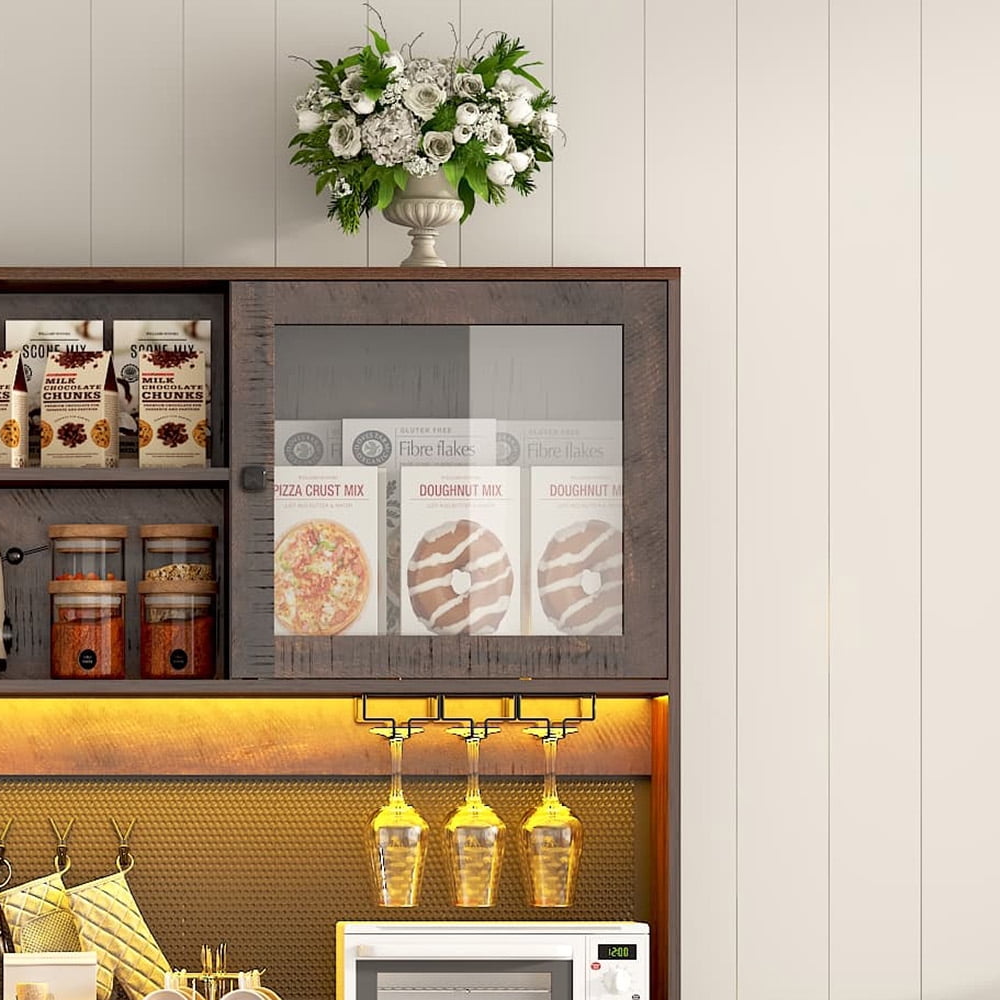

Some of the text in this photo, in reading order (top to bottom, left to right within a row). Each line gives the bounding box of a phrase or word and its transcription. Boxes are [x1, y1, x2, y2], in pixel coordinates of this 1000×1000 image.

[43, 392, 101, 400] CHUNKS
[142, 392, 203, 400] CHUNKS
[399, 440, 476, 456] Fibre flakes
[527, 442, 561, 458] Fibre
[274, 484, 364, 496] PIZZA CRUST MIX
[420, 484, 502, 496] DOUGHNUT MIX
[550, 484, 608, 497] DOUGHNUT
[608, 947, 629, 957] 12:00
